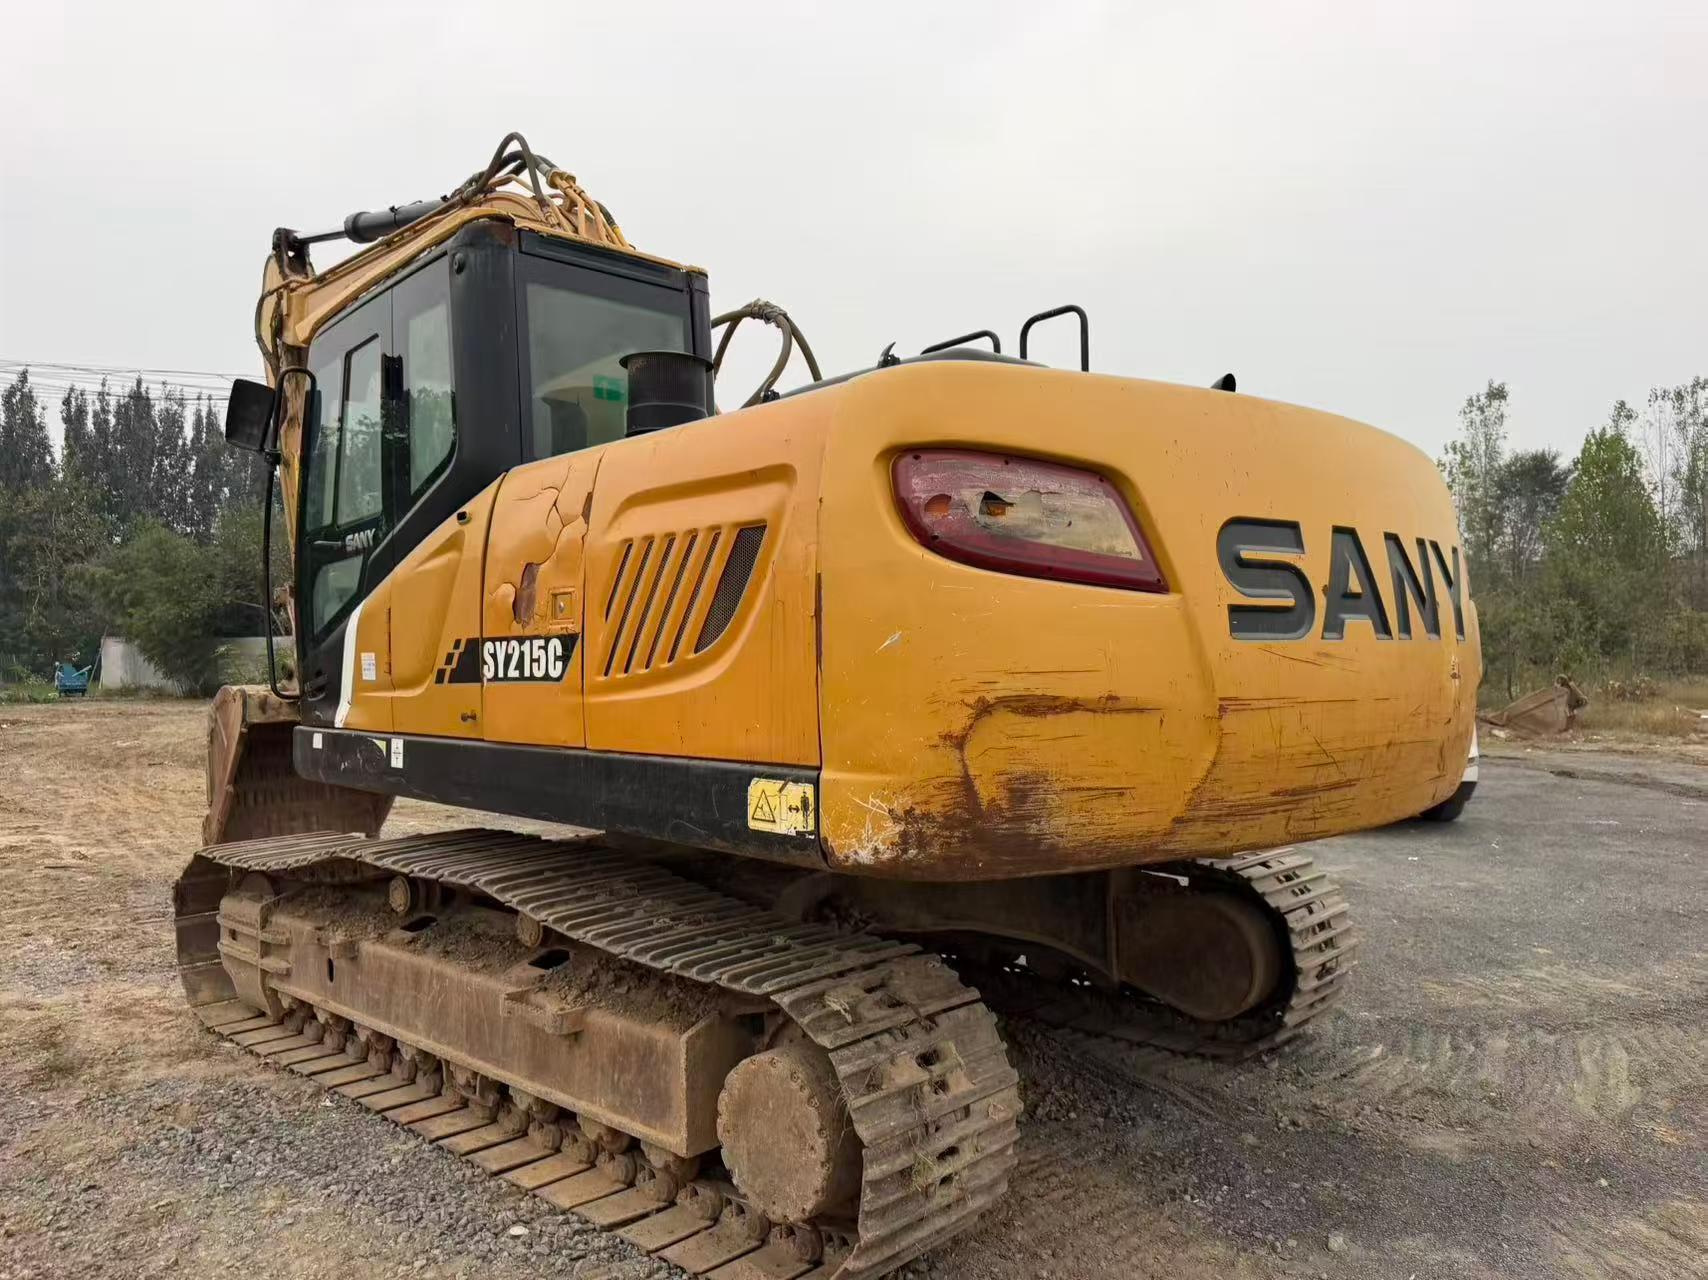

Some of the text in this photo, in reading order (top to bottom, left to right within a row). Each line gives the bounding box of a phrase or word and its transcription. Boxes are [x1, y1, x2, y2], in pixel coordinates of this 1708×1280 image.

[345, 528, 376, 552] SANY
[1216, 515, 1465, 641] SANY
[483, 638, 563, 679] SY215C
